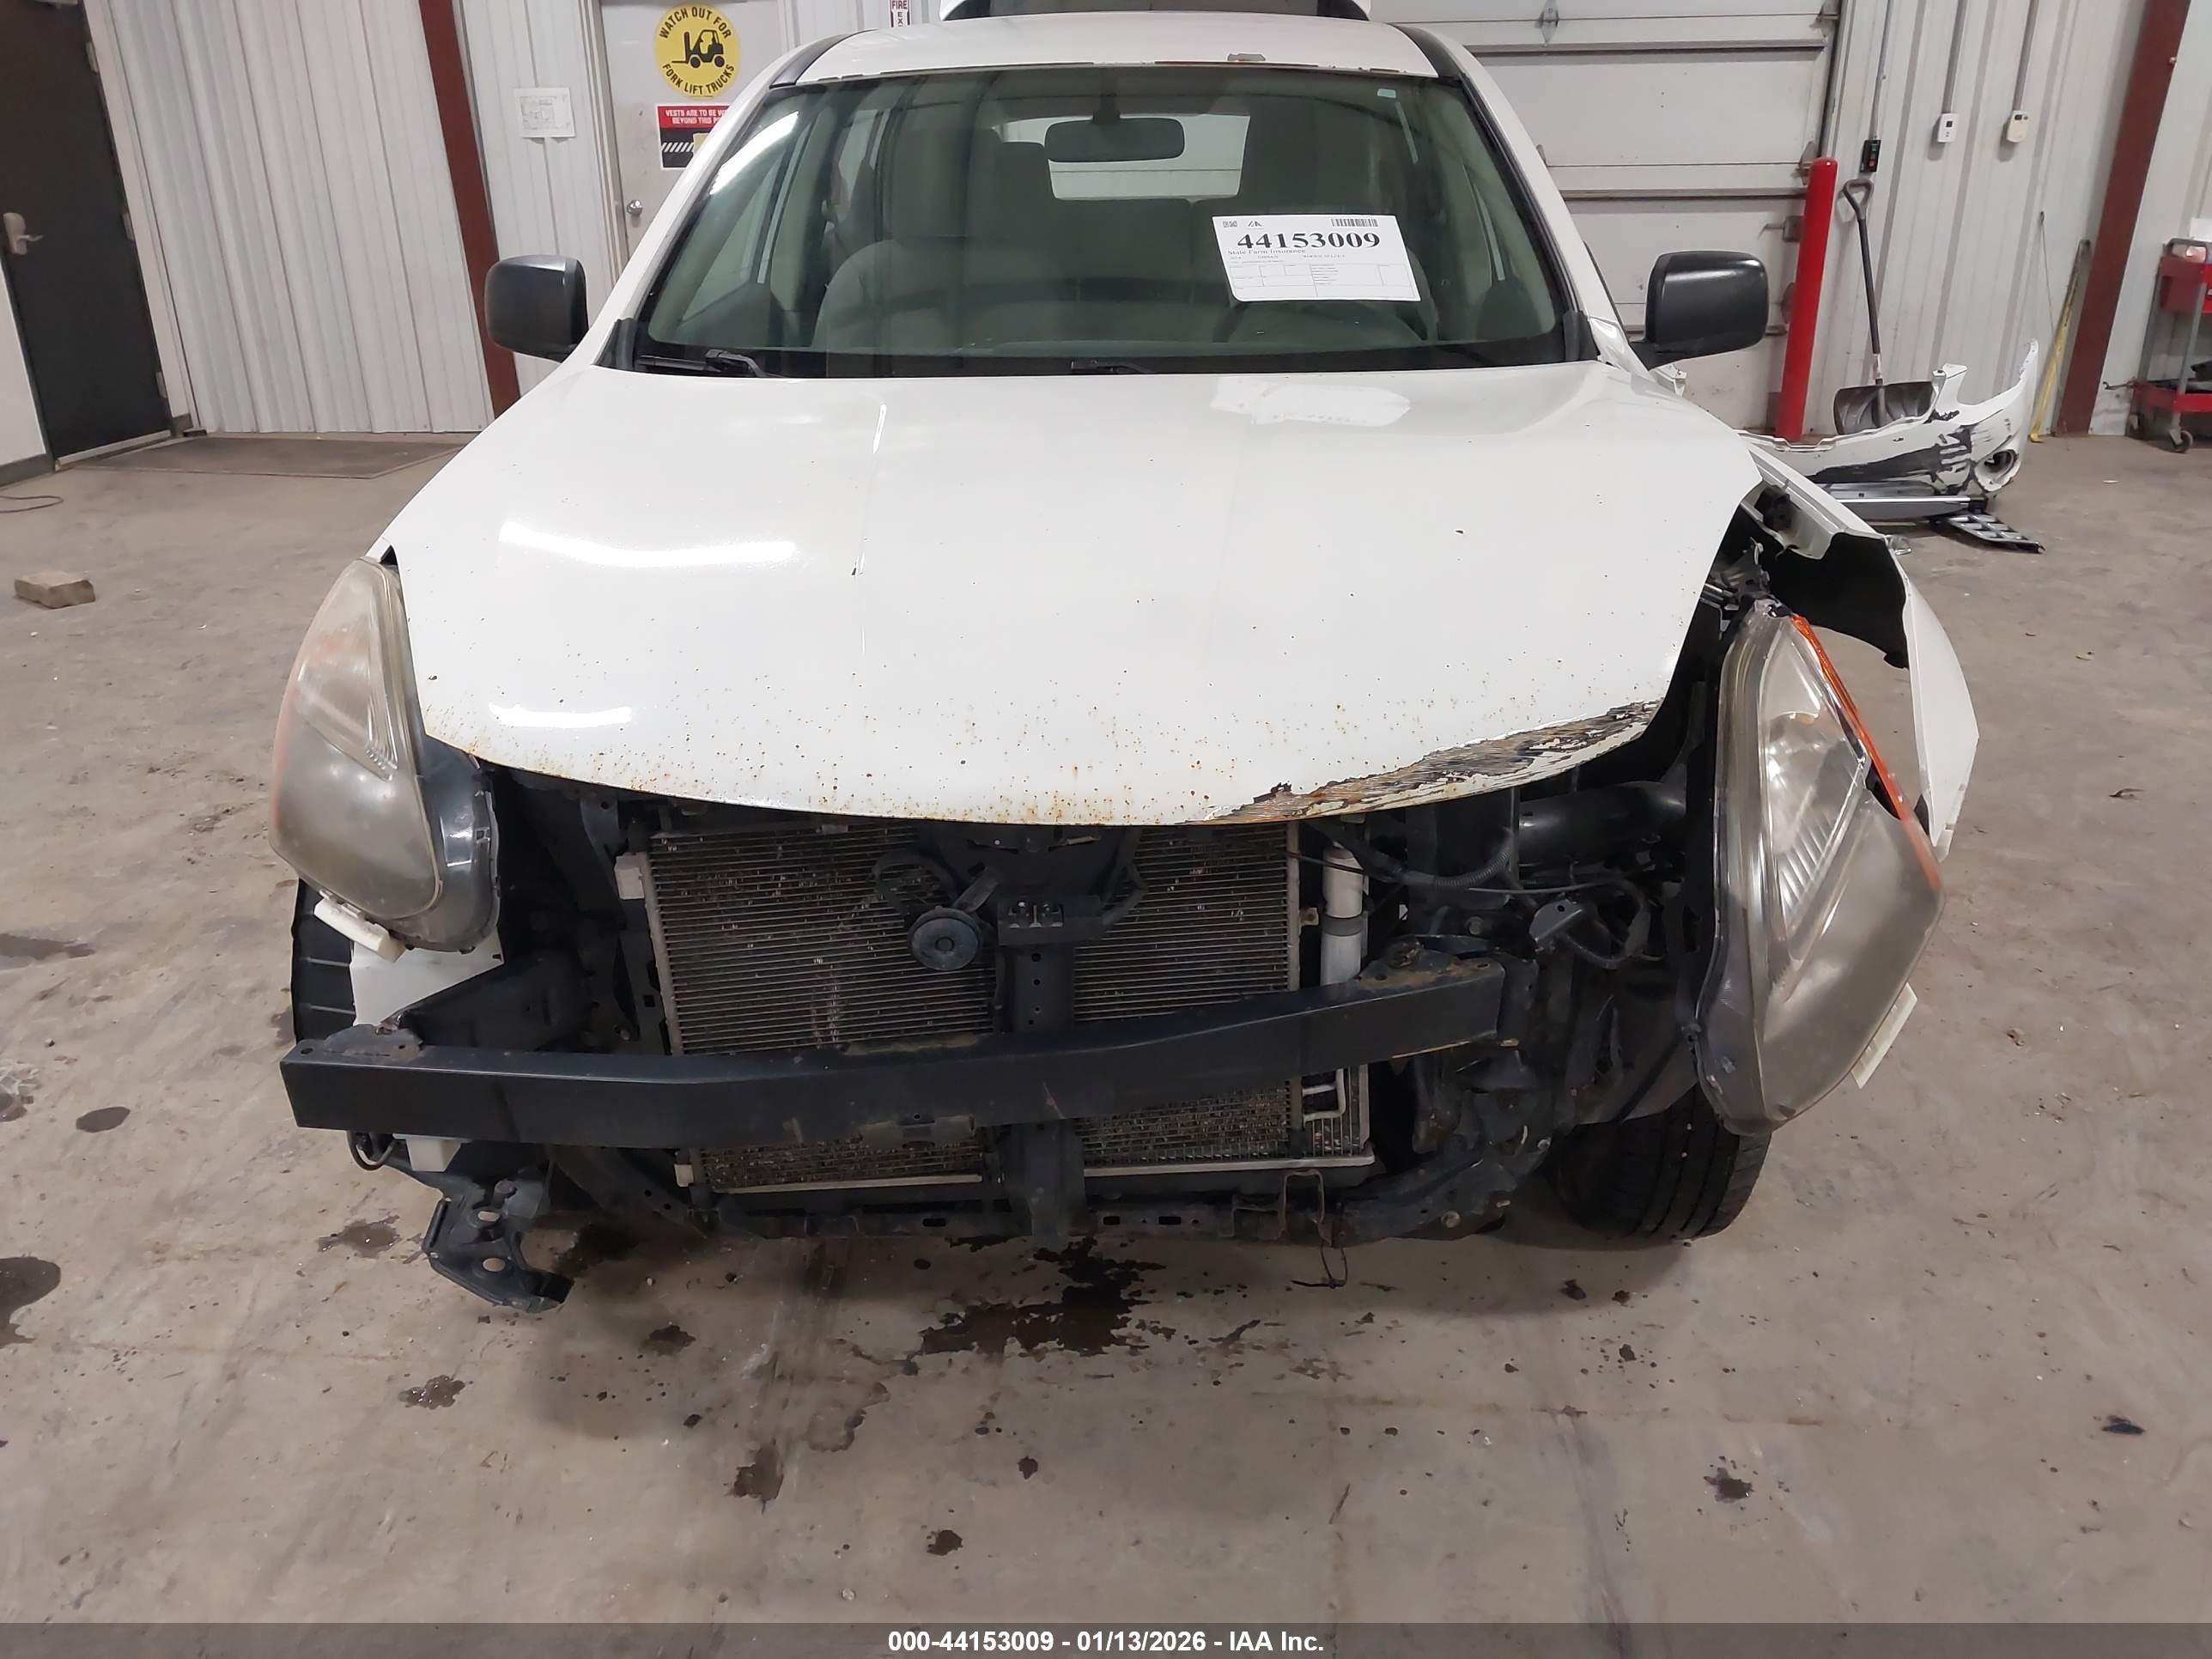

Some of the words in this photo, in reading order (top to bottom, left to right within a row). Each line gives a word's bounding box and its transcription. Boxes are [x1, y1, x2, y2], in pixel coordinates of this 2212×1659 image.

[892, 0, 908, 9] FIRE
[659, 8, 689, 39] WATCH
[691, 6, 713, 21] OUT
[713, 15, 732, 39] FOR
[662, 63, 684, 88] FORK
[684, 82, 703, 94] LIFT
[705, 64, 735, 94] TRUCKS
[1237, 232, 1380, 248] 44153009
